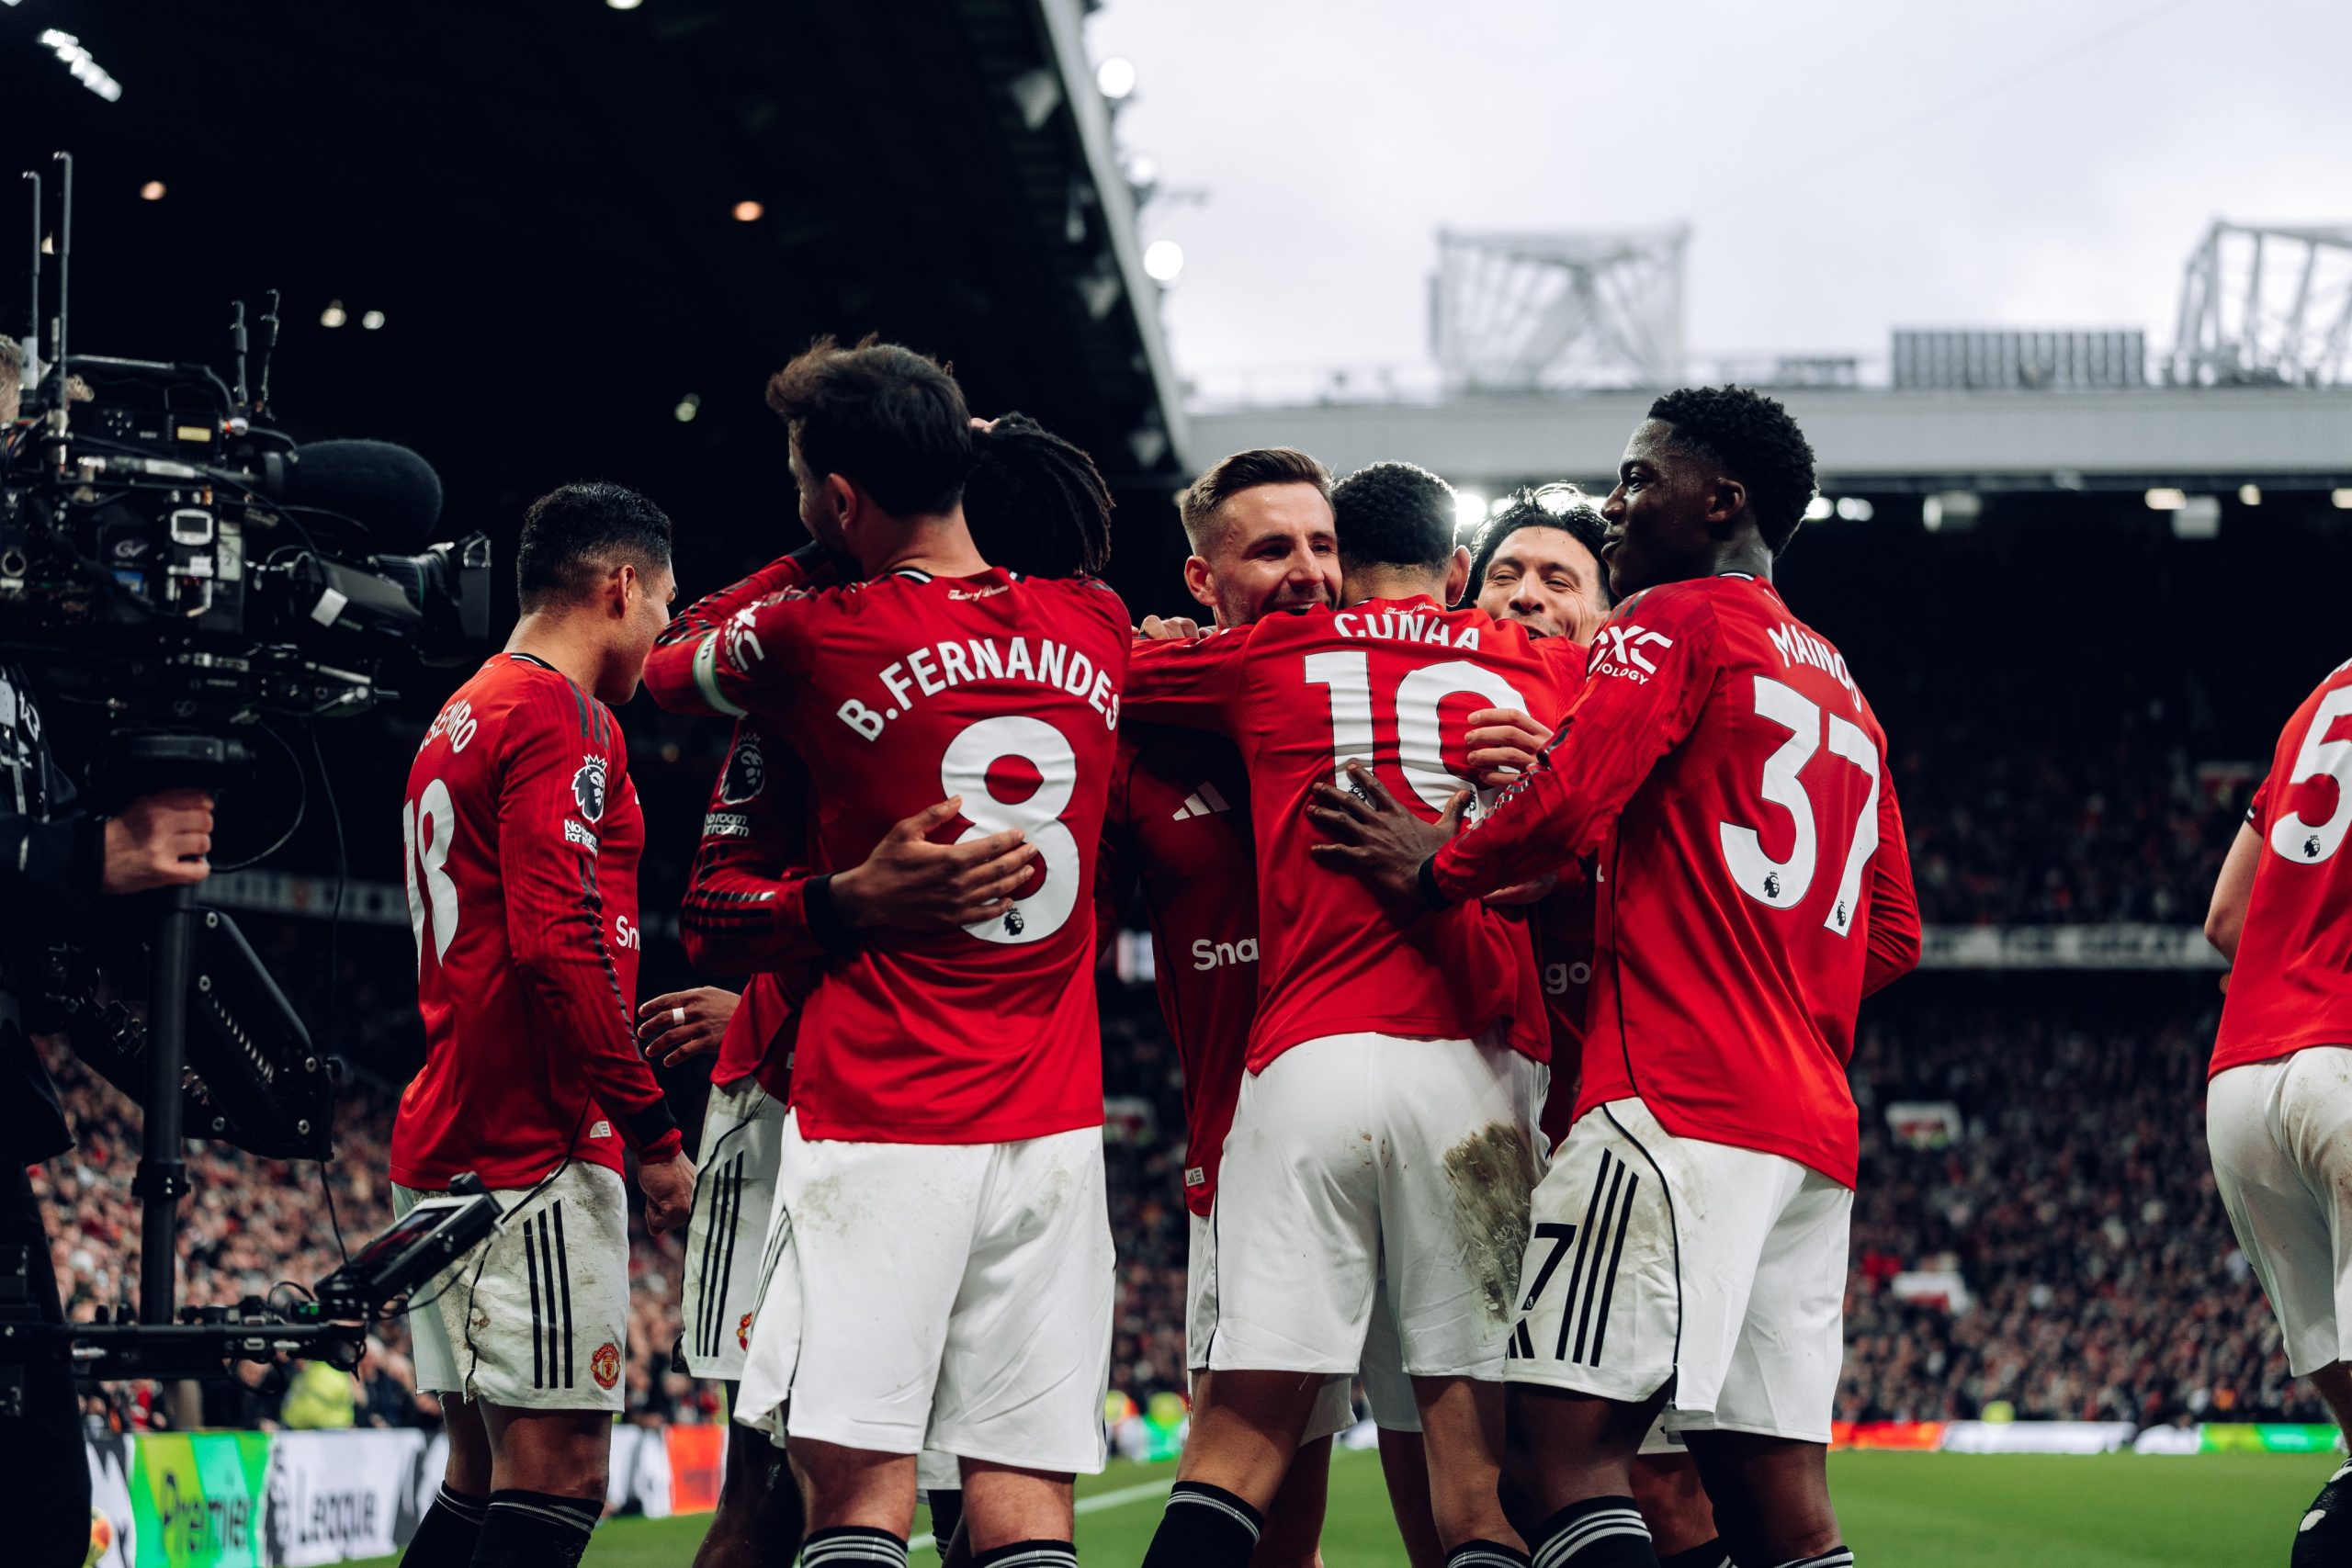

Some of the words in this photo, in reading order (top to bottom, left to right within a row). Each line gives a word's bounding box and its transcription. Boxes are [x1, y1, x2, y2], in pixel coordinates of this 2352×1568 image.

[836, 637, 1119, 741] B.FERNANDES
[1334, 613, 1479, 651] CUNHA
[716, 814, 747, 825] room
[1304, 651, 1532, 825] 10
[1720, 675, 1881, 938] 37
[2271, 683, 2352, 864] 5
[402, 778, 459, 985] 18
[942, 716, 1080, 944] 8
[1521, 1223, 1577, 1312] 7
